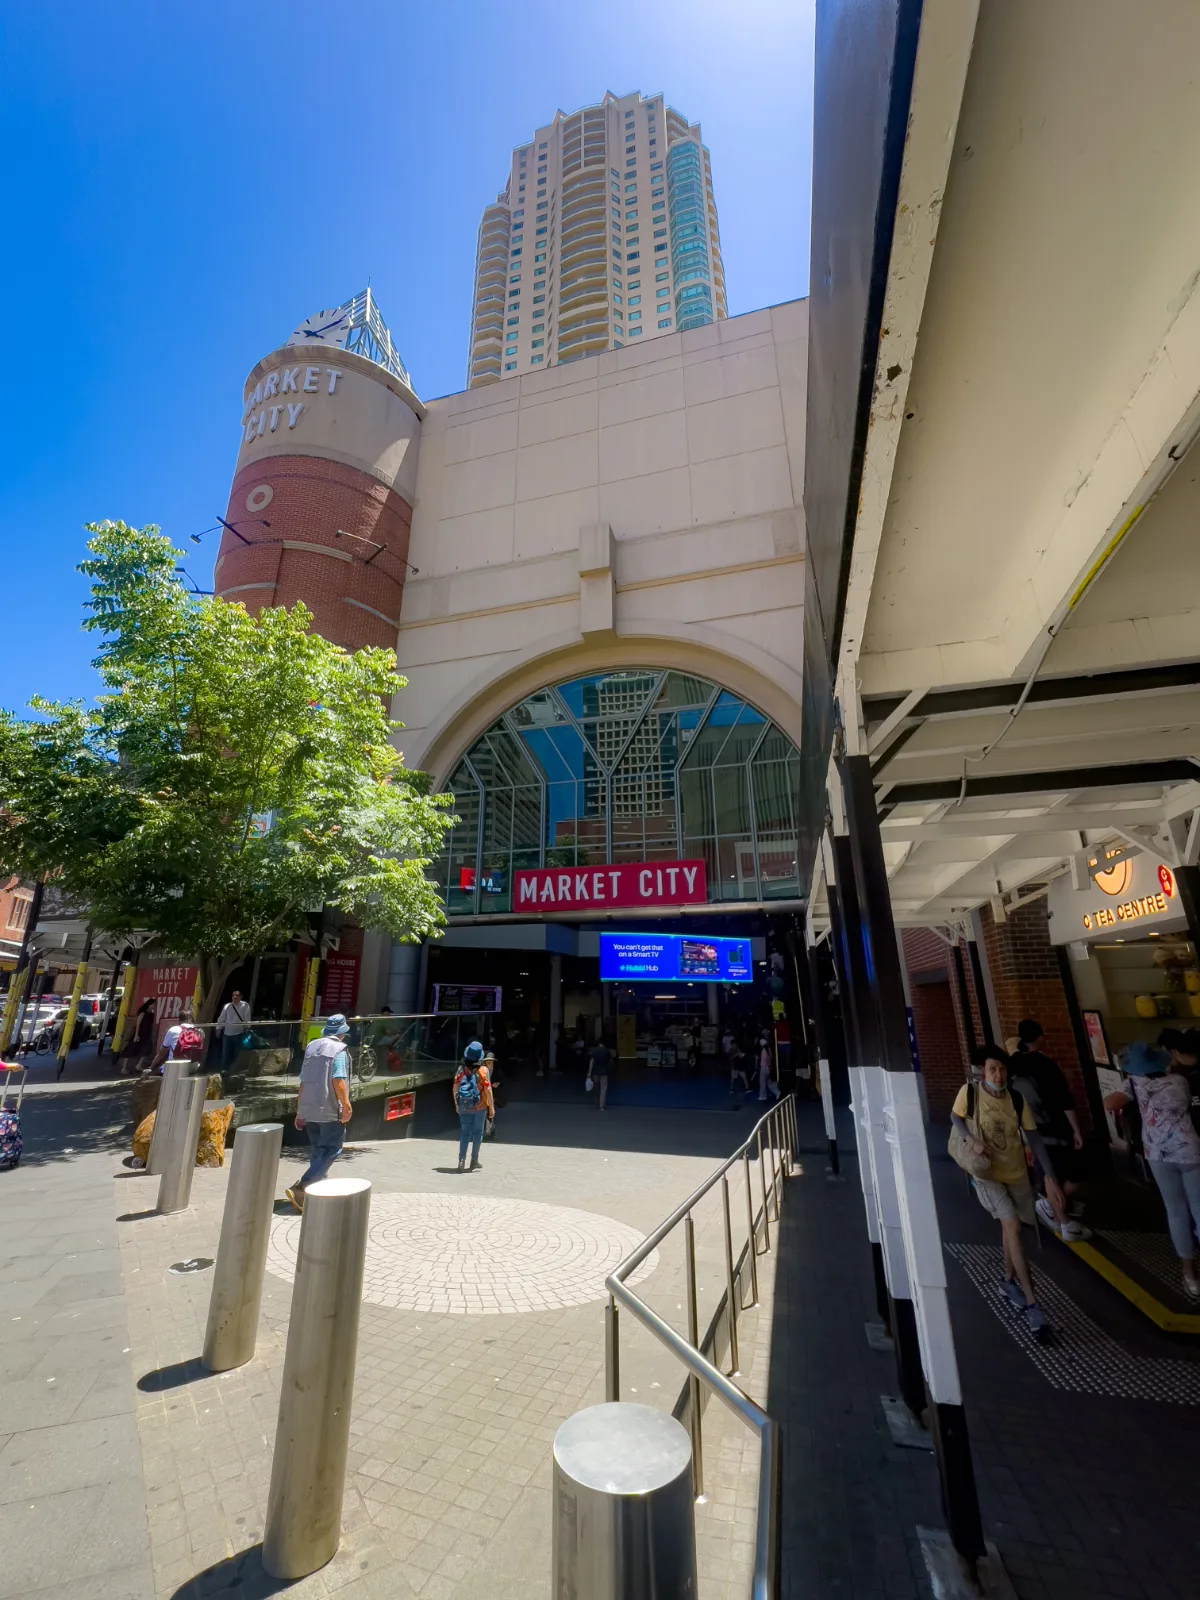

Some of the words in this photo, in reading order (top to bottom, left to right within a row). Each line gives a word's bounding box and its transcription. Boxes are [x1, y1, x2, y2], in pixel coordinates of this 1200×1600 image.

[245, 403, 304, 443] CITY
[520, 871, 621, 903] MARKET
[639, 866, 698, 897] CITY
[1083, 914, 1092, 930] C
[1093, 908, 1116, 928] TEA
[1117, 892, 1168, 922] CENTRE
[153, 968, 190, 980] MARKET
[157, 982, 179, 994] CITY
